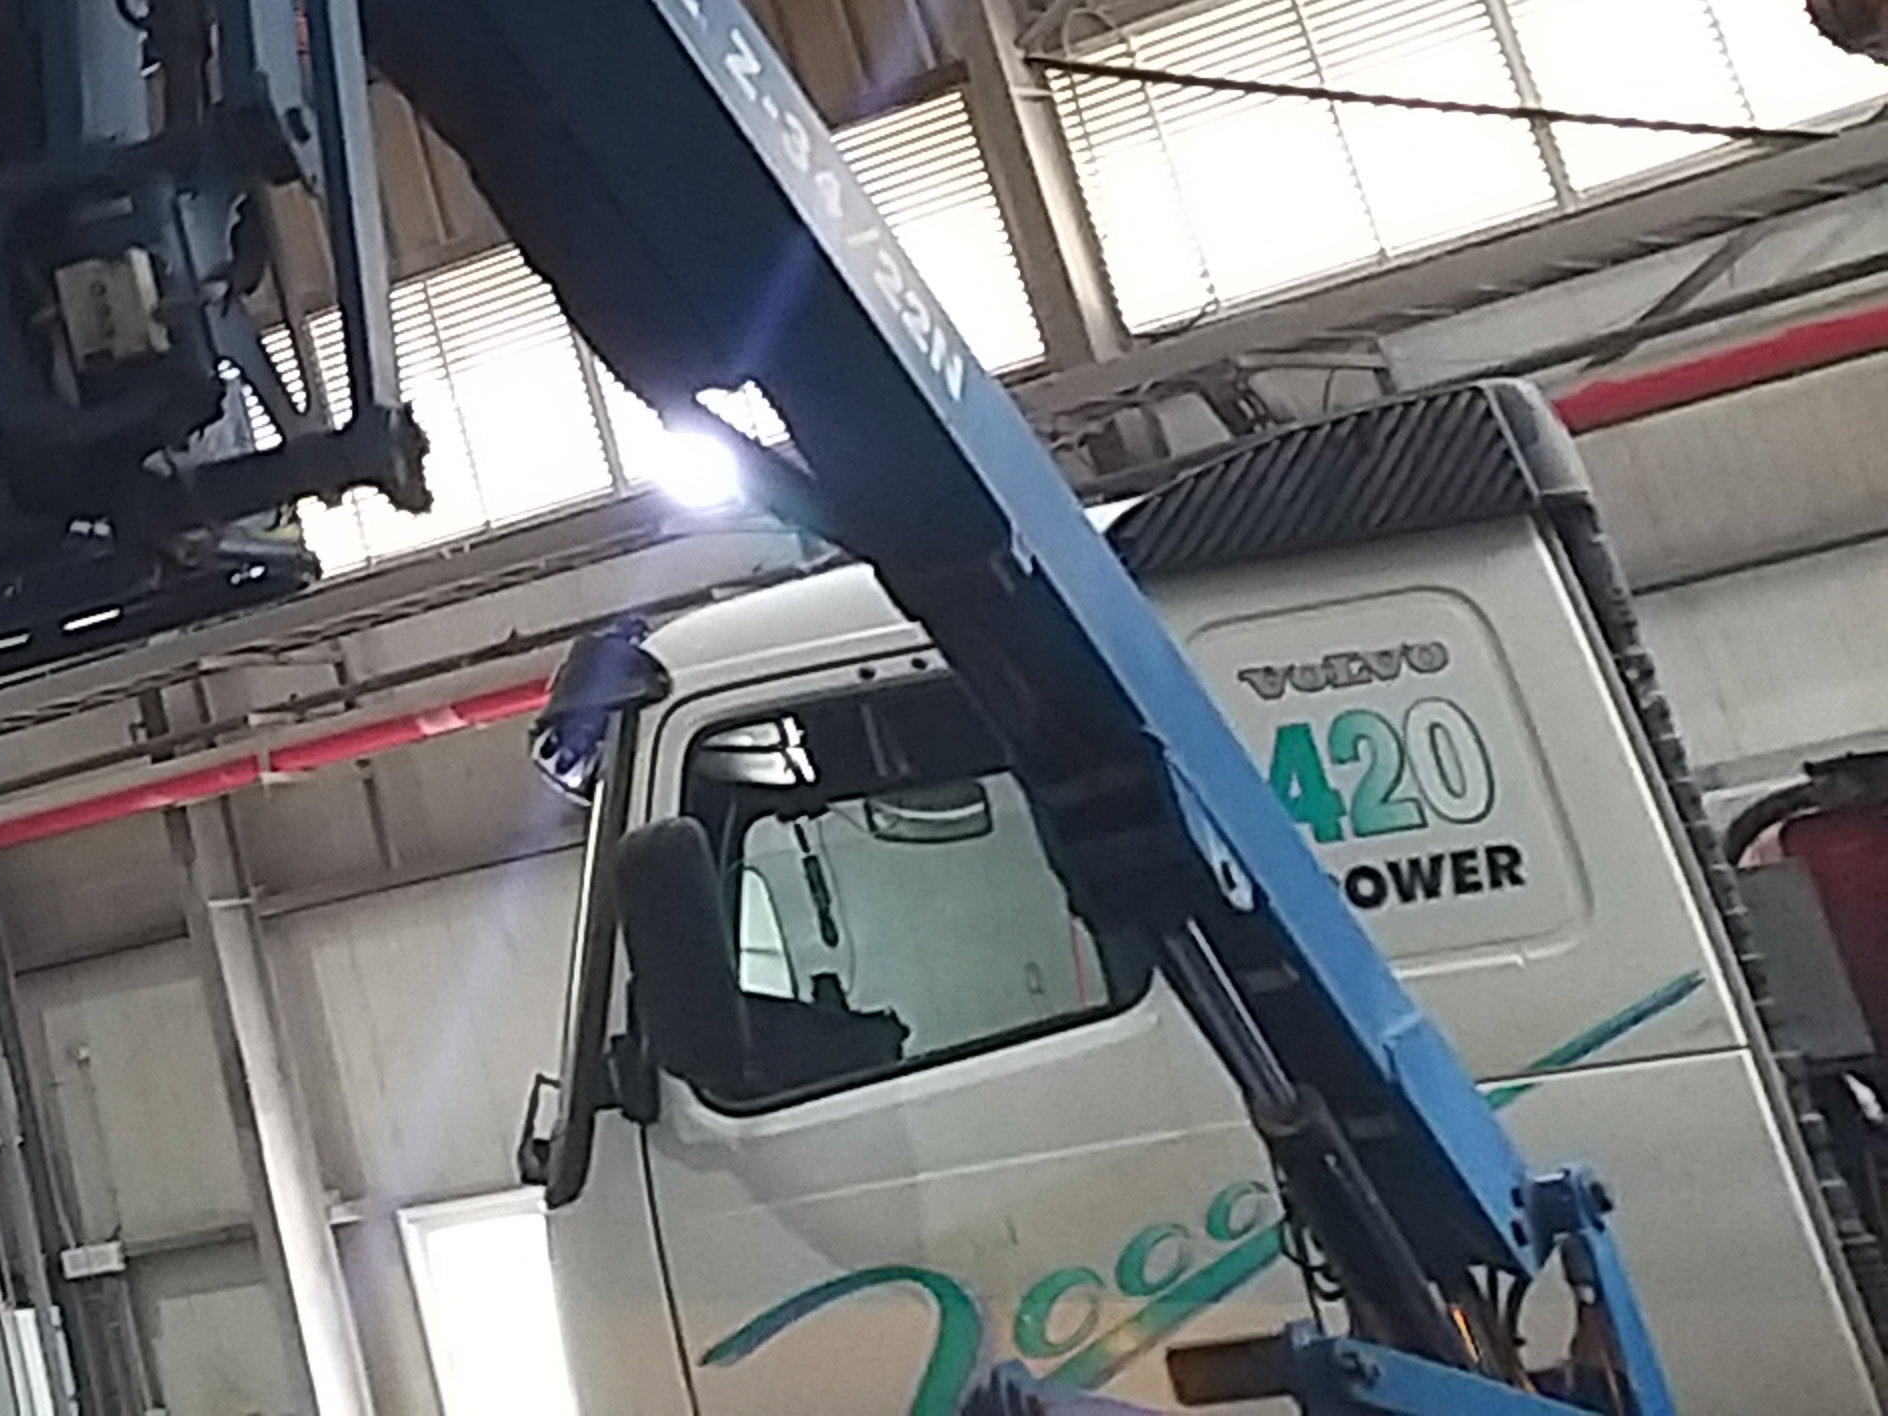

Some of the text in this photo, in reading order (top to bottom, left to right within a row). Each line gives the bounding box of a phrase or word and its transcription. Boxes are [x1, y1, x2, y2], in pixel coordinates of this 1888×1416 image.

[1239, 639, 1449, 700] VOLVO
[1268, 696, 1496, 844] 420
[1328, 844, 1526, 910] OWER
